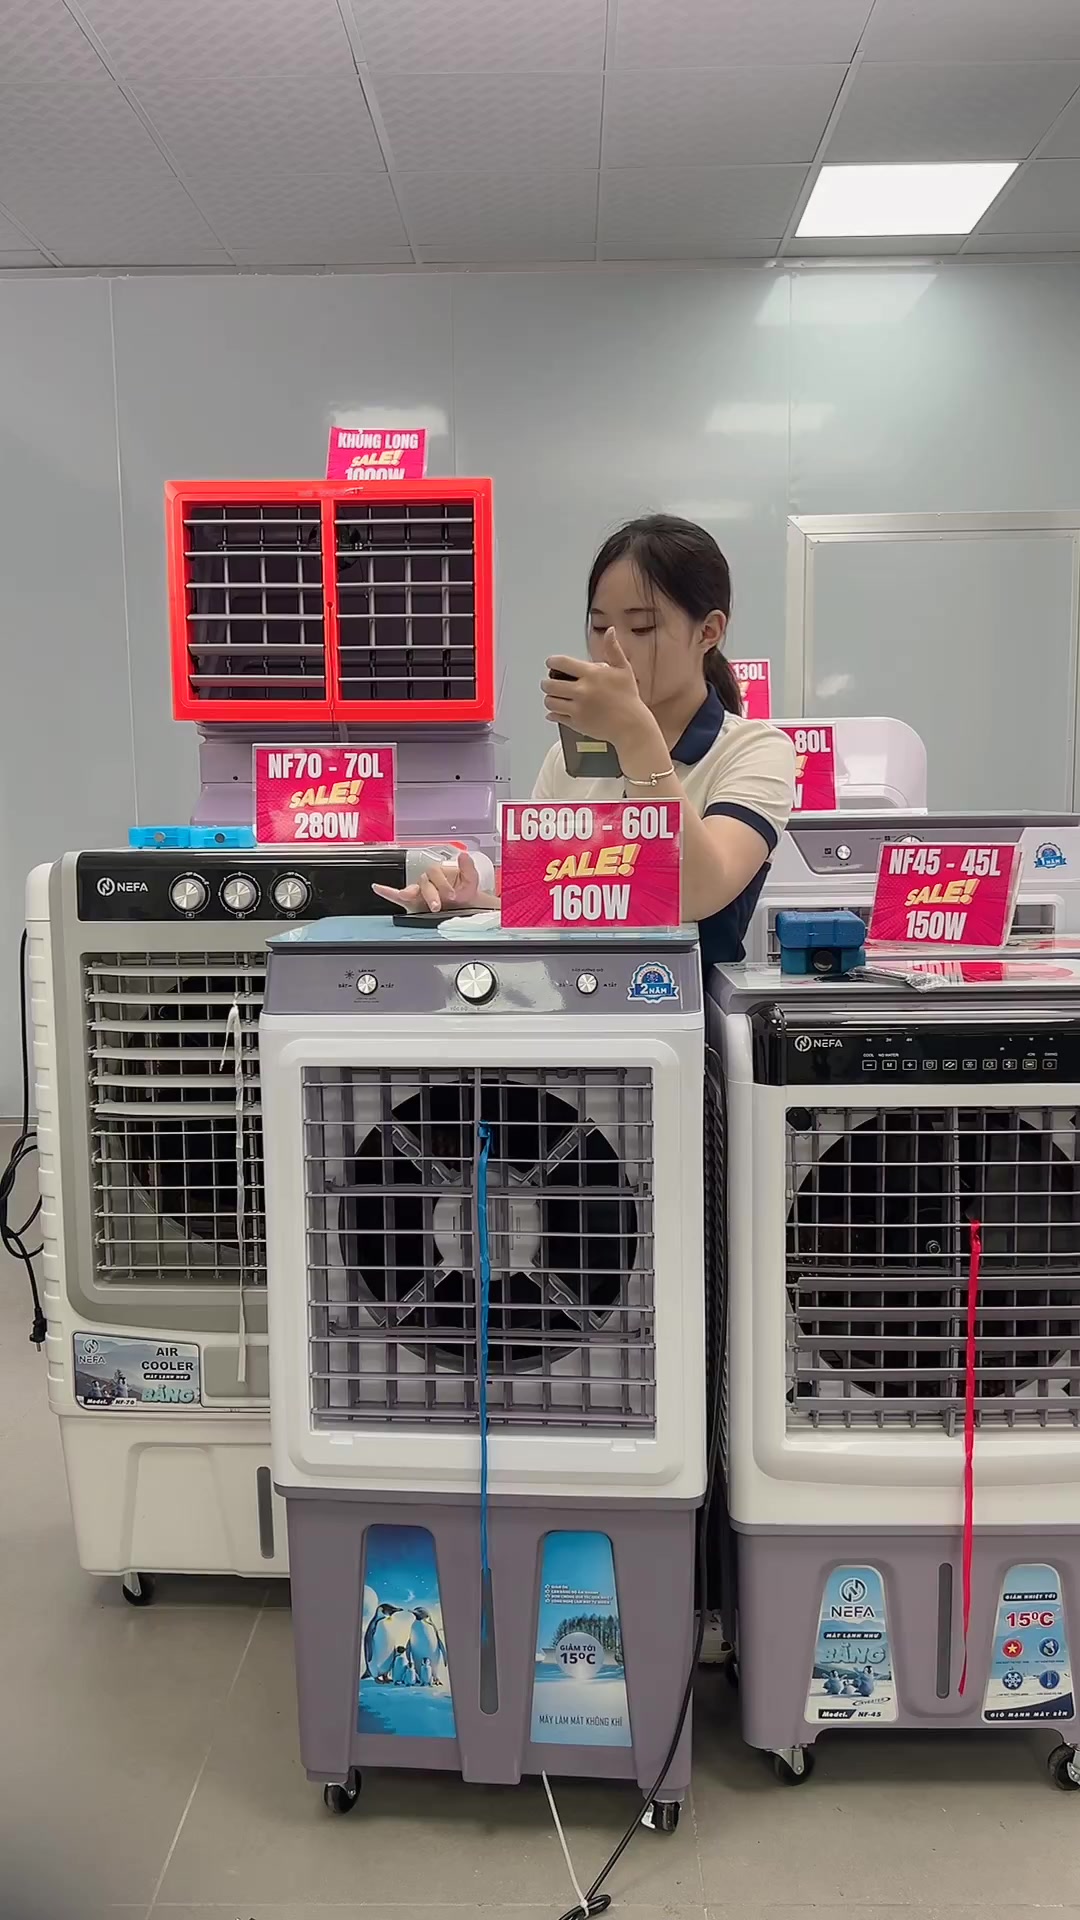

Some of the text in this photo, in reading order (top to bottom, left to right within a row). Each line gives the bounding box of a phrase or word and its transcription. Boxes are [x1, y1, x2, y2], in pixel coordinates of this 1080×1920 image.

[338, 430, 419, 449] KHỦNG LONG
[350, 450, 404, 467] SALE!
[345, 468, 405, 480] 1000W
[794, 729, 830, 753] 80L
[268, 753, 322, 779] NF70
[344, 753, 384, 779] 70L
[289, 780, 364, 809] SALE!
[294, 812, 359, 839] 280W
[506, 807, 593, 841] L6800
[622, 806, 674, 839] 60L
[543, 843, 641, 882] SALE!
[888, 848, 941, 875] NF45
[960, 848, 1001, 877] 45L
[117, 881, 149, 892] NEFA
[904, 878, 980, 907] SALE!
[549, 884, 630, 921] 160W
[906, 910, 967, 941] 150W
[640, 983, 648, 995] 2
[813, 1039, 843, 1048] NEFA
[79, 1355, 106, 1365] NEFA
[156, 1347, 179, 1357] AIR
[141, 1361, 194, 1371] COOLER
[831, 1606, 875, 1618] NEFA
[560, 1643, 596, 1652] GIẢM TỚI
[585, 1714, 609, 1727] KHÔNG
